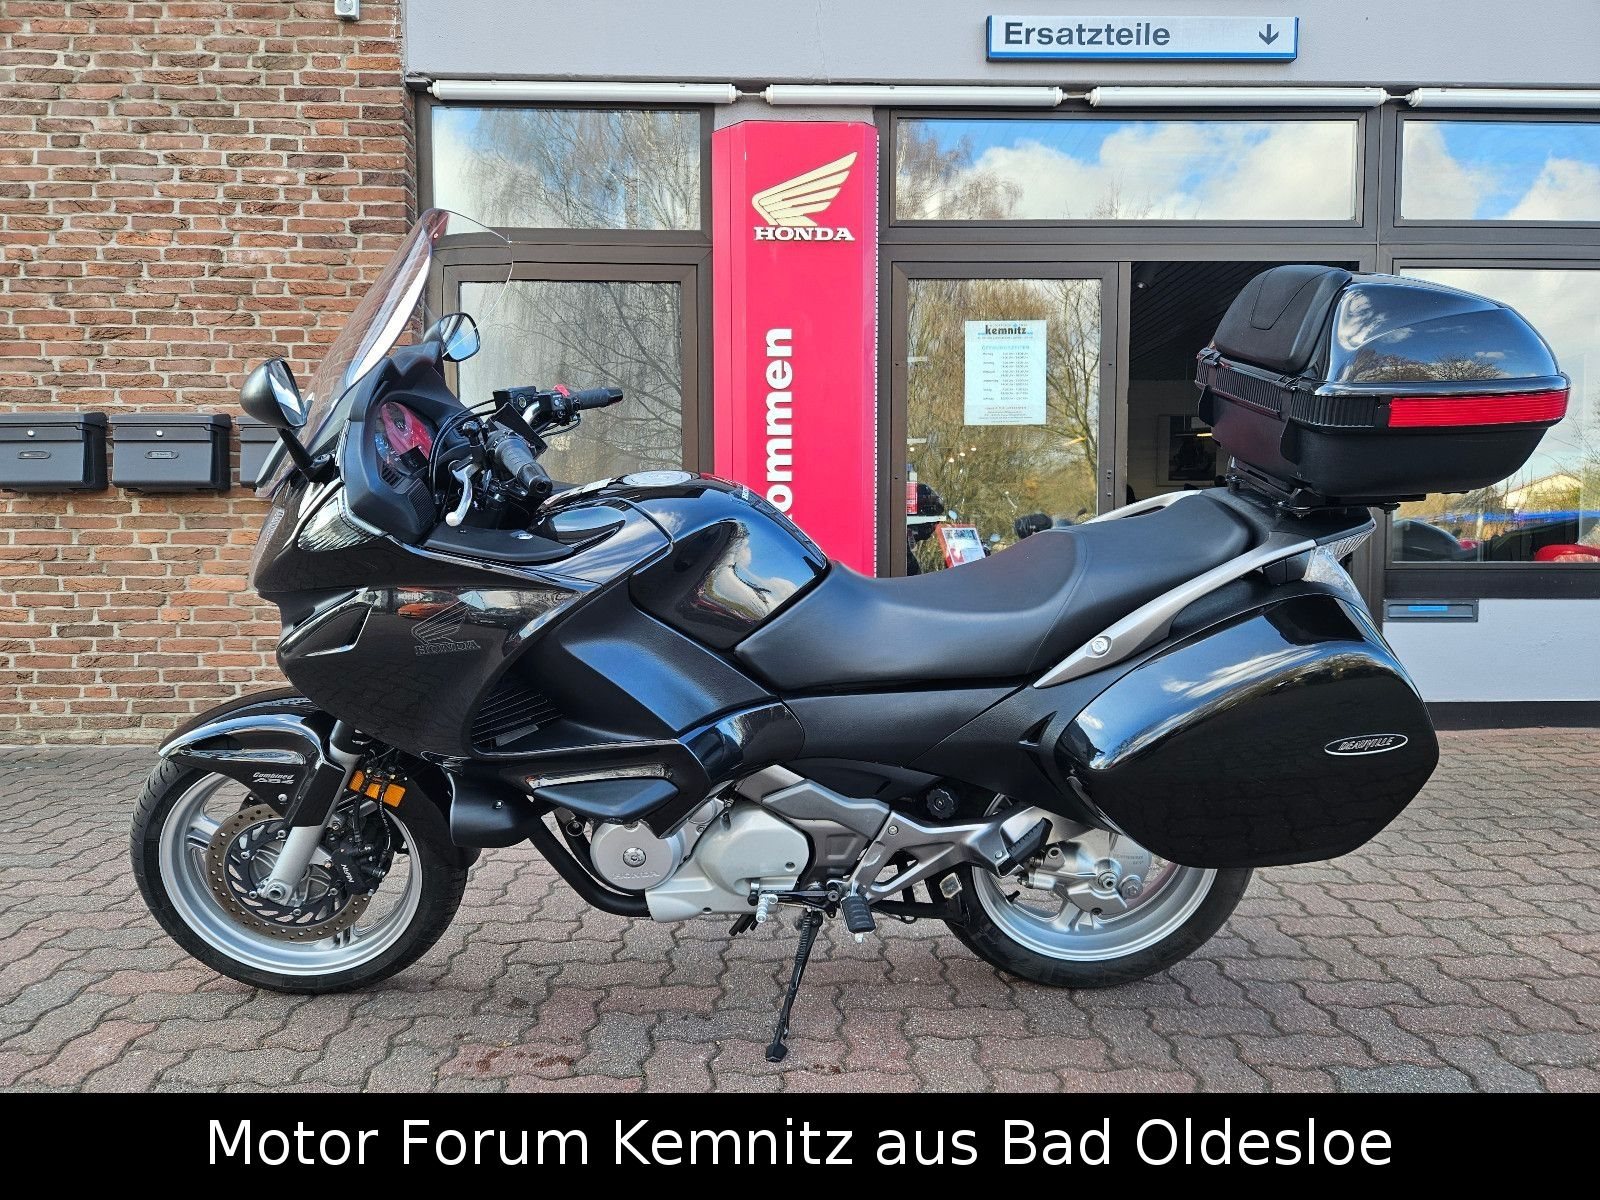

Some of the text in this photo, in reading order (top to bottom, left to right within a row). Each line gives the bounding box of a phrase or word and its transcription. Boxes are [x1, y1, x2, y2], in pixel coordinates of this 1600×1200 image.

[1004, 21, 1171, 46] Ersatzteile
[753, 226, 856, 241] HONDA
[985, 324, 1027, 335] kemnitz
[765, 328, 793, 519] ommen
[414, 639, 481, 656] HONDA
[1338, 736, 1396, 751] DEAUVILLE
[252, 771, 295, 780] Combined
